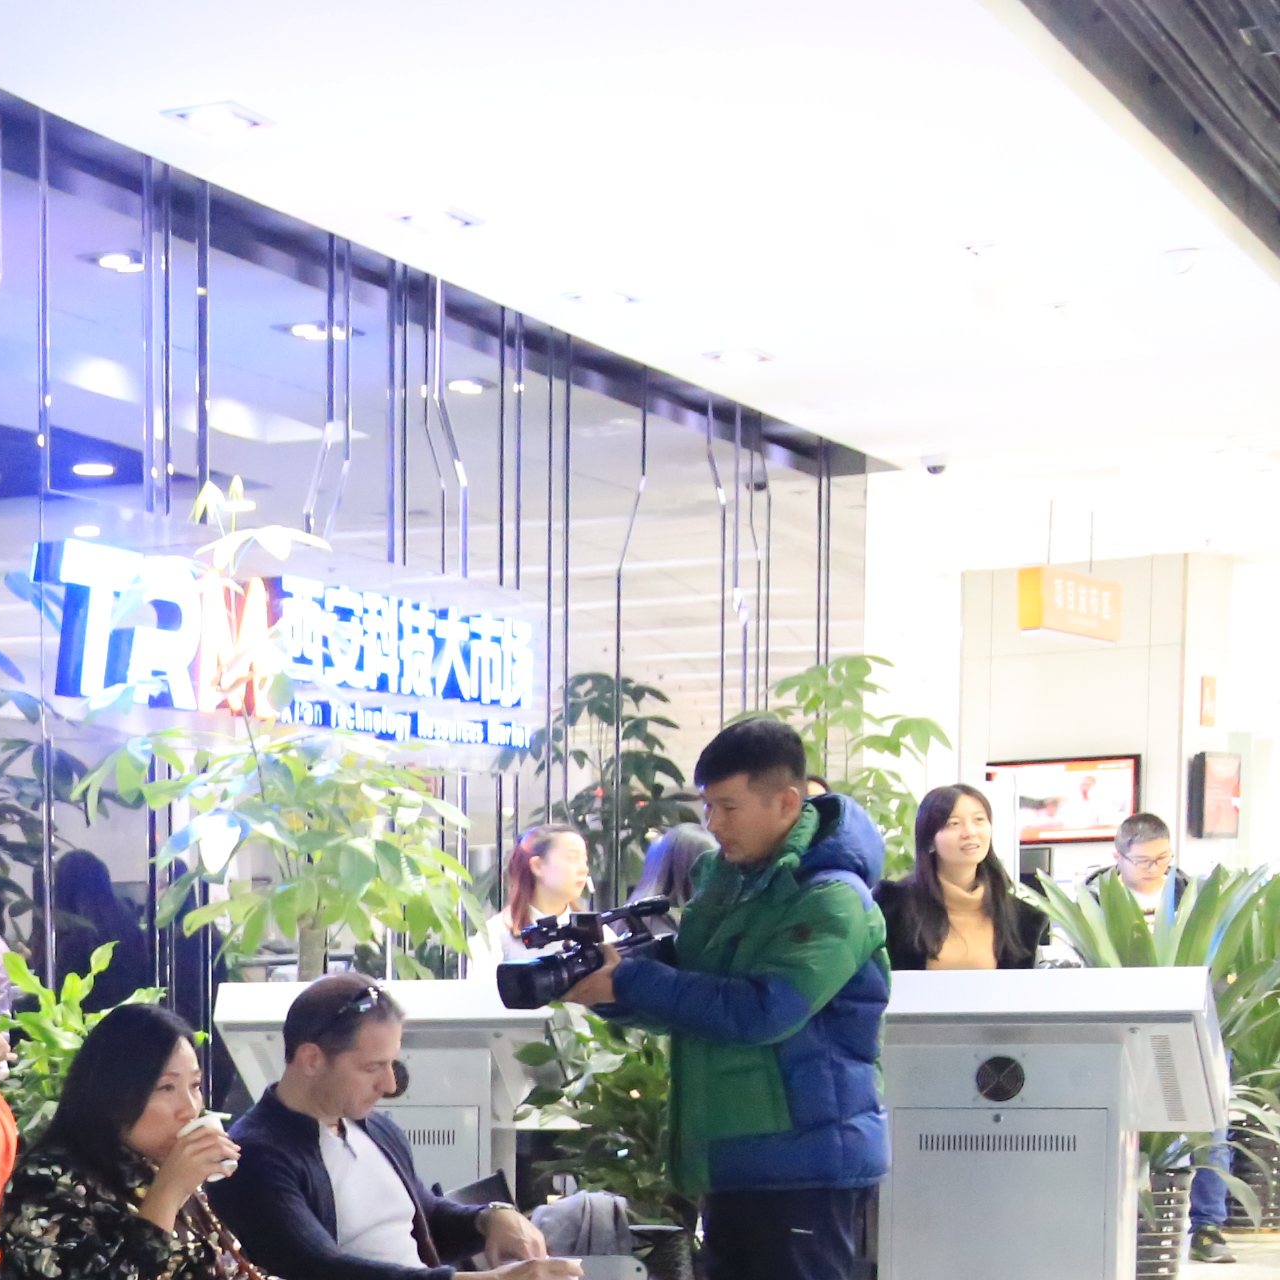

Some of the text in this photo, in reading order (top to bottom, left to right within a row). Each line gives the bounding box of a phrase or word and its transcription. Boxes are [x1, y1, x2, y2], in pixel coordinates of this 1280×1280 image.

[32, 538, 280, 721] TRM
[282, 574, 533, 708] 西安科技大市场
[329, 699, 412, 742] Technology
[417, 709, 484, 744] Resources
[487, 717, 531, 749] Market
